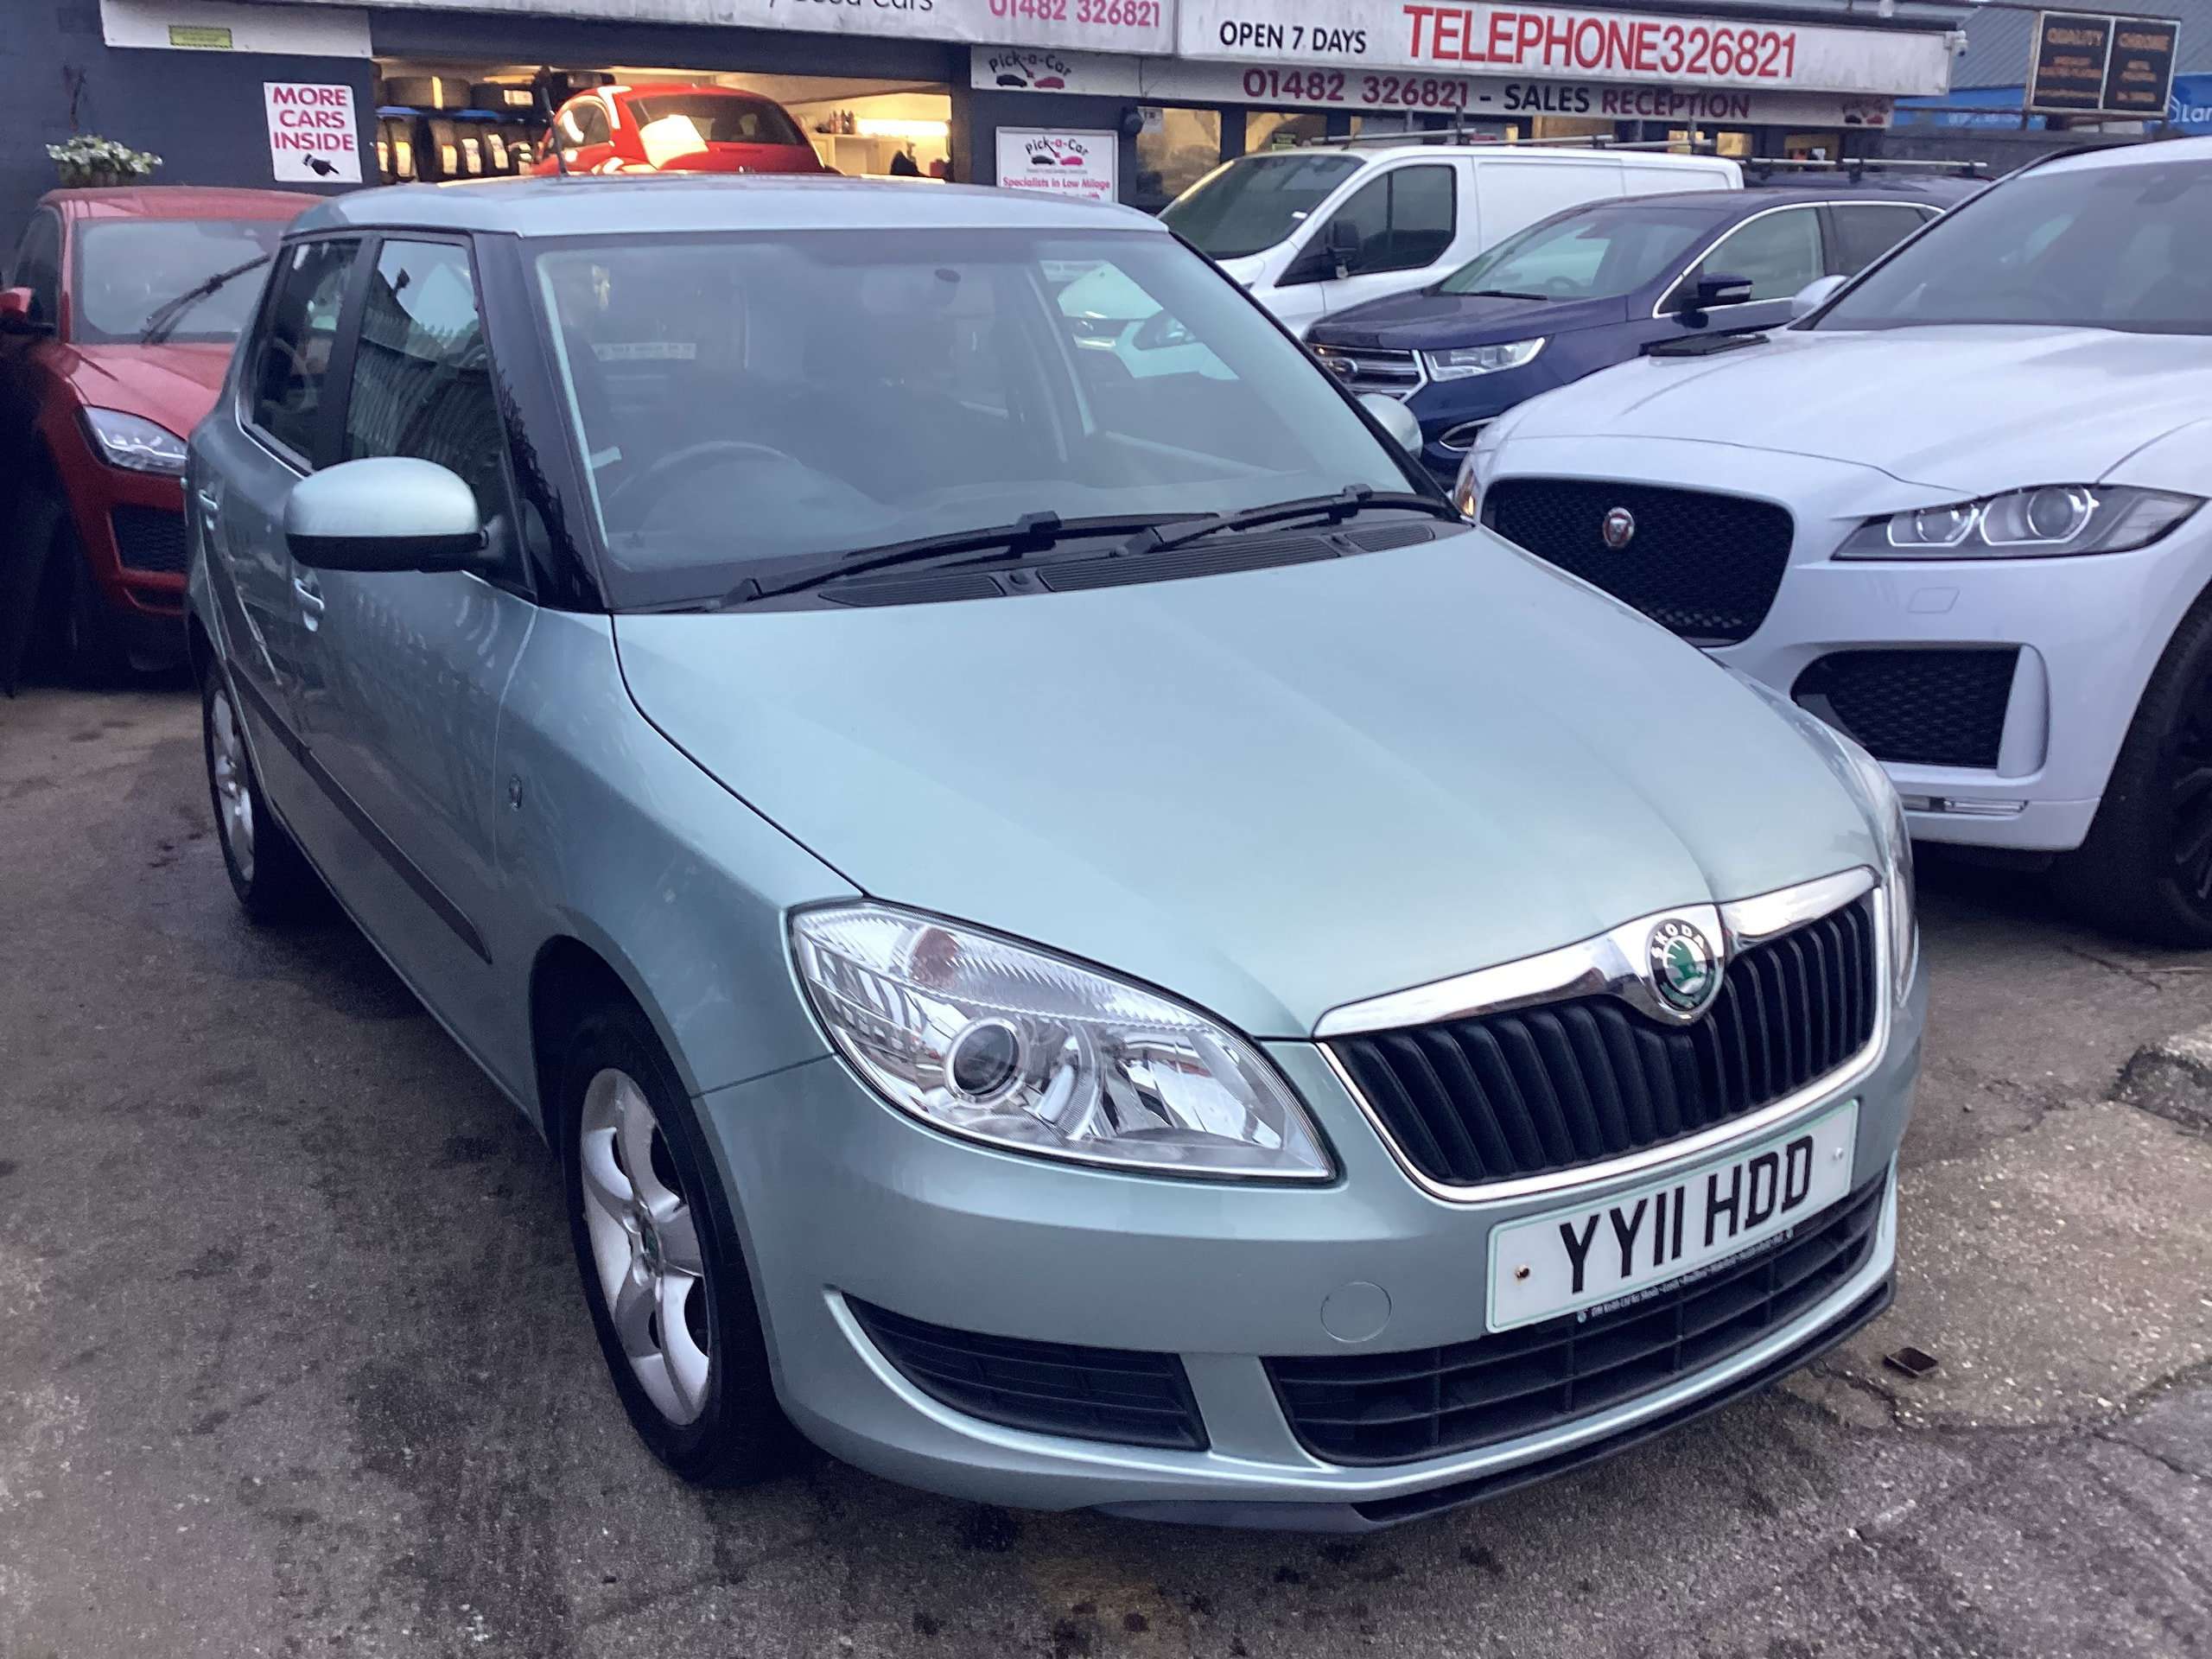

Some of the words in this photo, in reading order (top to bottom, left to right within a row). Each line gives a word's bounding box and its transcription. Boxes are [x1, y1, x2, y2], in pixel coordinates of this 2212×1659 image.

[989, 0, 1067, 21] 01482
[1077, 0, 1160, 28] 326821
[1220, 21, 1284, 49] OPEN
[1292, 26, 1304, 50] 7
[1313, 28, 1366, 54] DAYS
[1403, 5, 1796, 78] TELEPHONE326821
[273, 86, 347, 106] MORE
[1243, 67, 1344, 102] 01482
[1362, 76, 1468, 108] 326821
[1503, 84, 1590, 113] SALES
[1601, 89, 1751, 119] RECEPTION
[279, 110, 346, 129] CARS
[274, 131, 355, 151] INSIDE
[1002, 176, 1049, 188] Specialists
[1559, 1185, 1685, 1294] YY11
[1704, 1135, 1814, 1248] HDD
